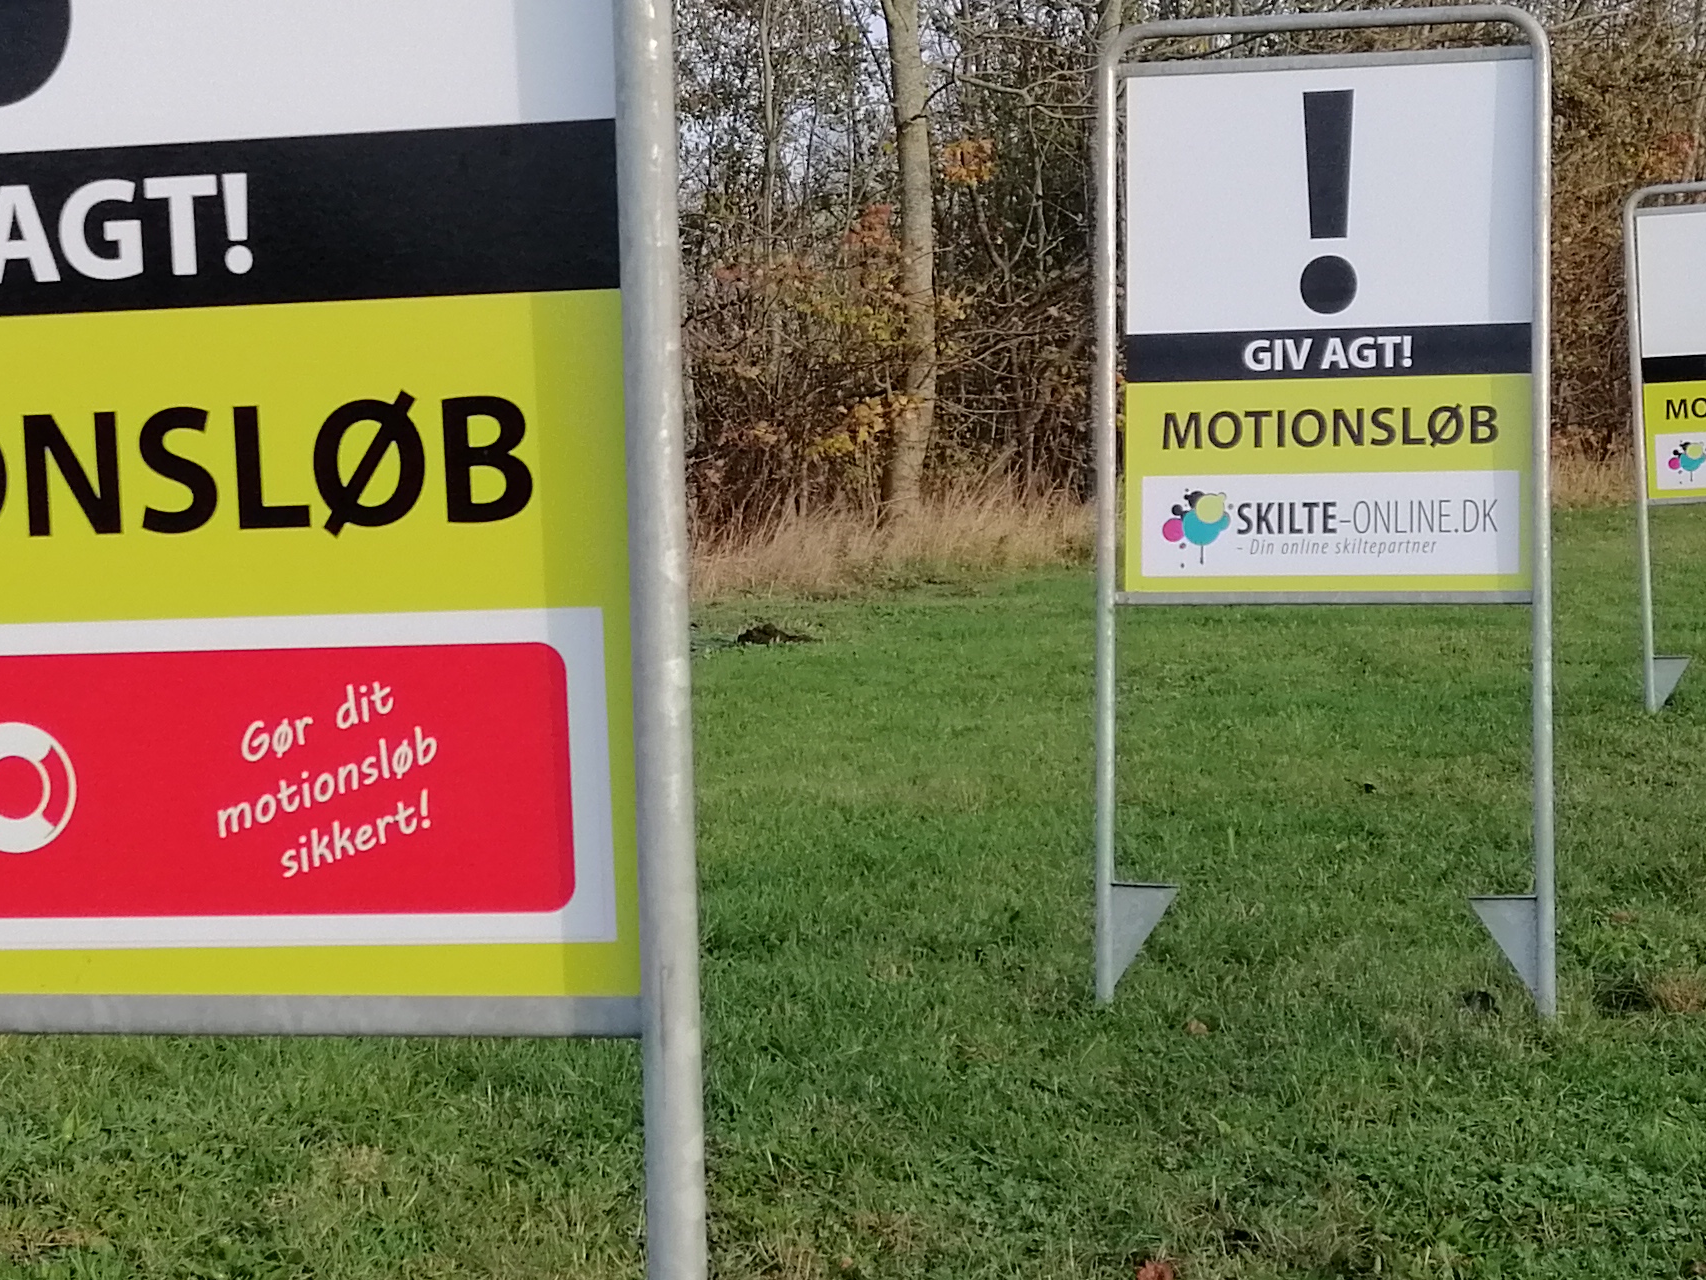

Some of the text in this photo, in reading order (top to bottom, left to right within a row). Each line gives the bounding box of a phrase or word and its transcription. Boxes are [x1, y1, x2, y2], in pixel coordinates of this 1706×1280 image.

[1243, 334, 1414, 372] GIV AGT!
[1161, 402, 1500, 451] MOTIONSLØB
[1235, 498, 1499, 536] SKILTE-ONLINE.DK
[1250, 538, 1275, 556] Din
[1280, 537, 1330, 555] online
[1334, 536, 1438, 558] skiltepartner
[241, 679, 395, 762] Gør dit
[216, 726, 438, 838] motionsløb
[279, 788, 432, 878] sikkert!
